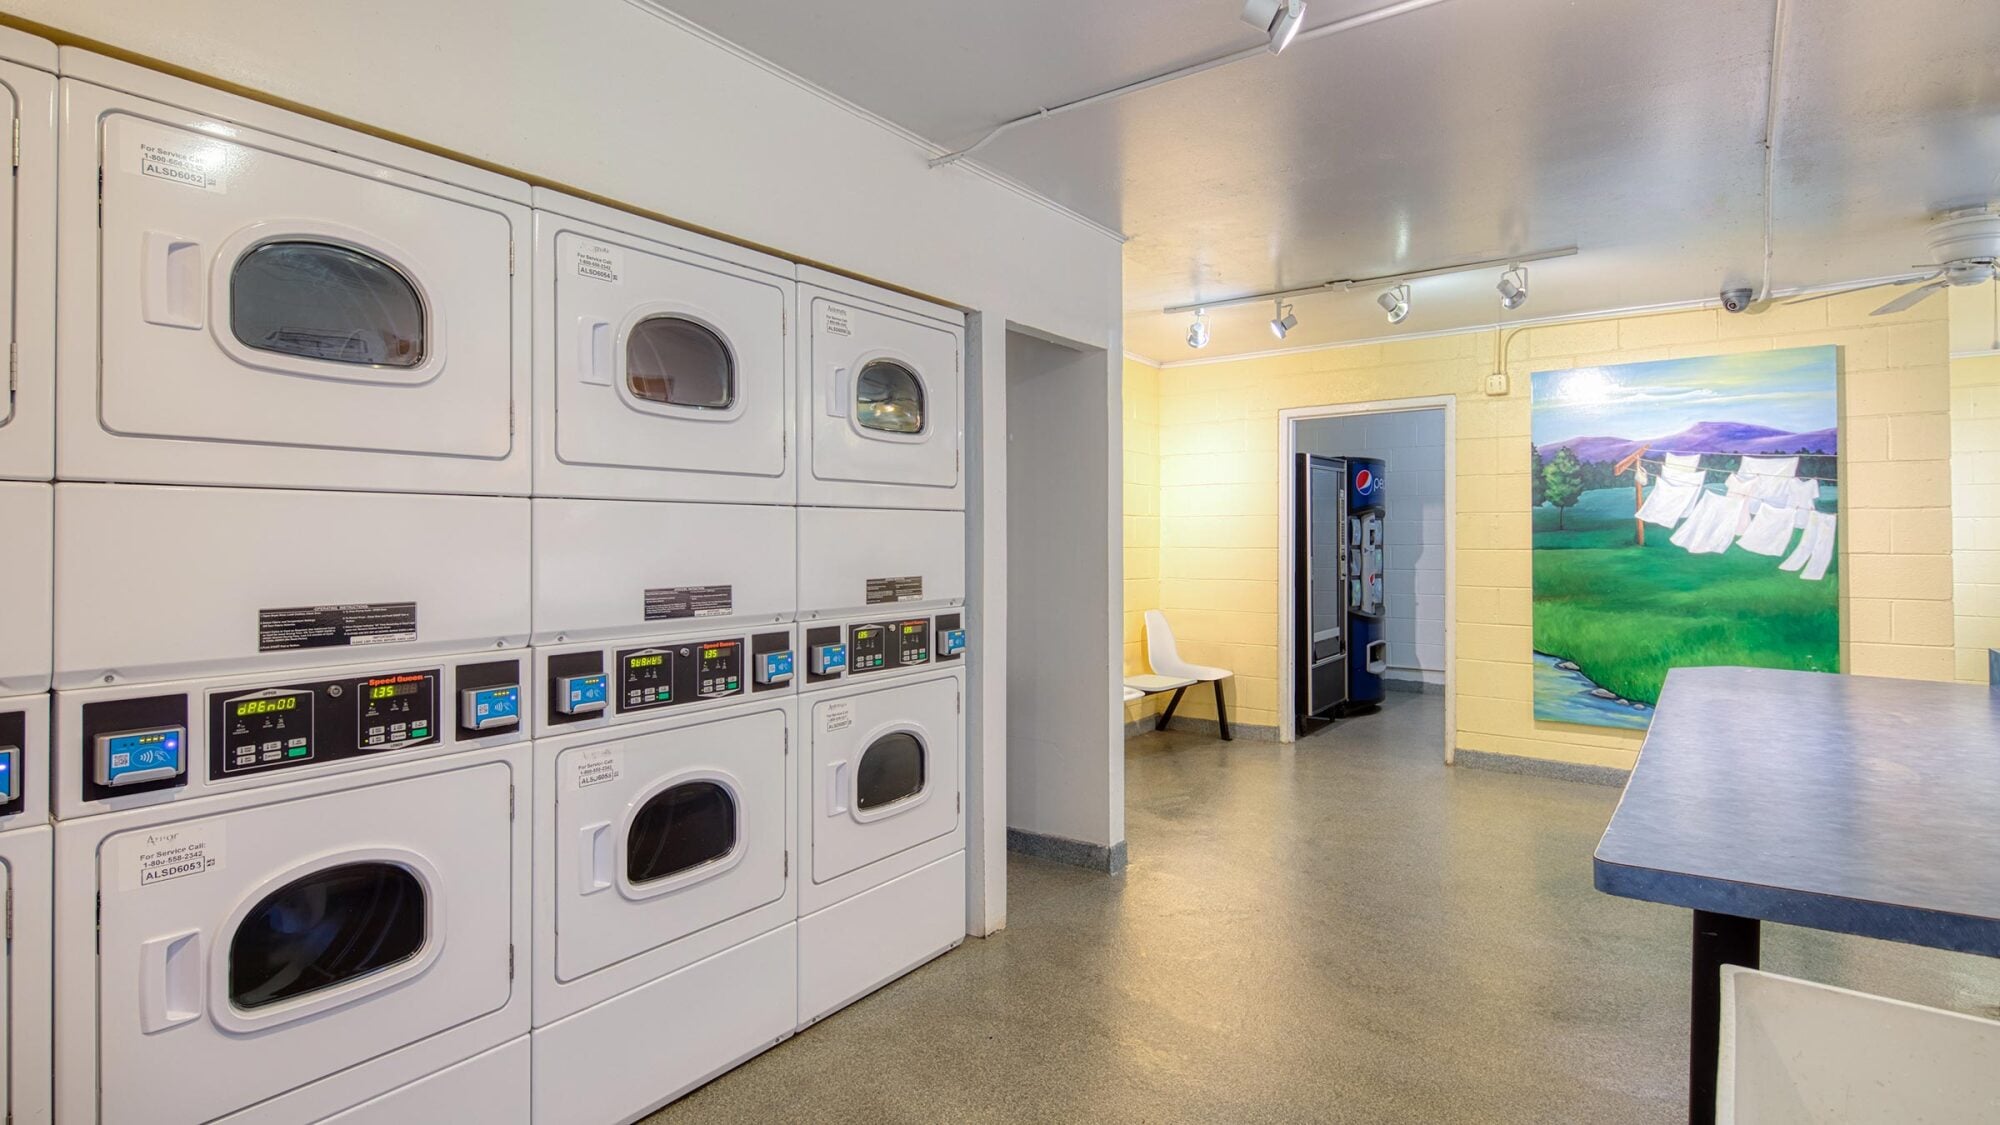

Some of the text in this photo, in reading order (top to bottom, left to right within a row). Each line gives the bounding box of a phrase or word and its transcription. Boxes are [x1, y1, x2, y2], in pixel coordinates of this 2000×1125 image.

[140, 143, 155, 153] For
[157, 148, 187, 160] Service
[146, 163, 203, 183] ALSD6052
[368, 674, 424, 687] Speed Queen
[140, 842, 206, 861] For Service Call:
[145, 861, 202, 881] ALSD6053
